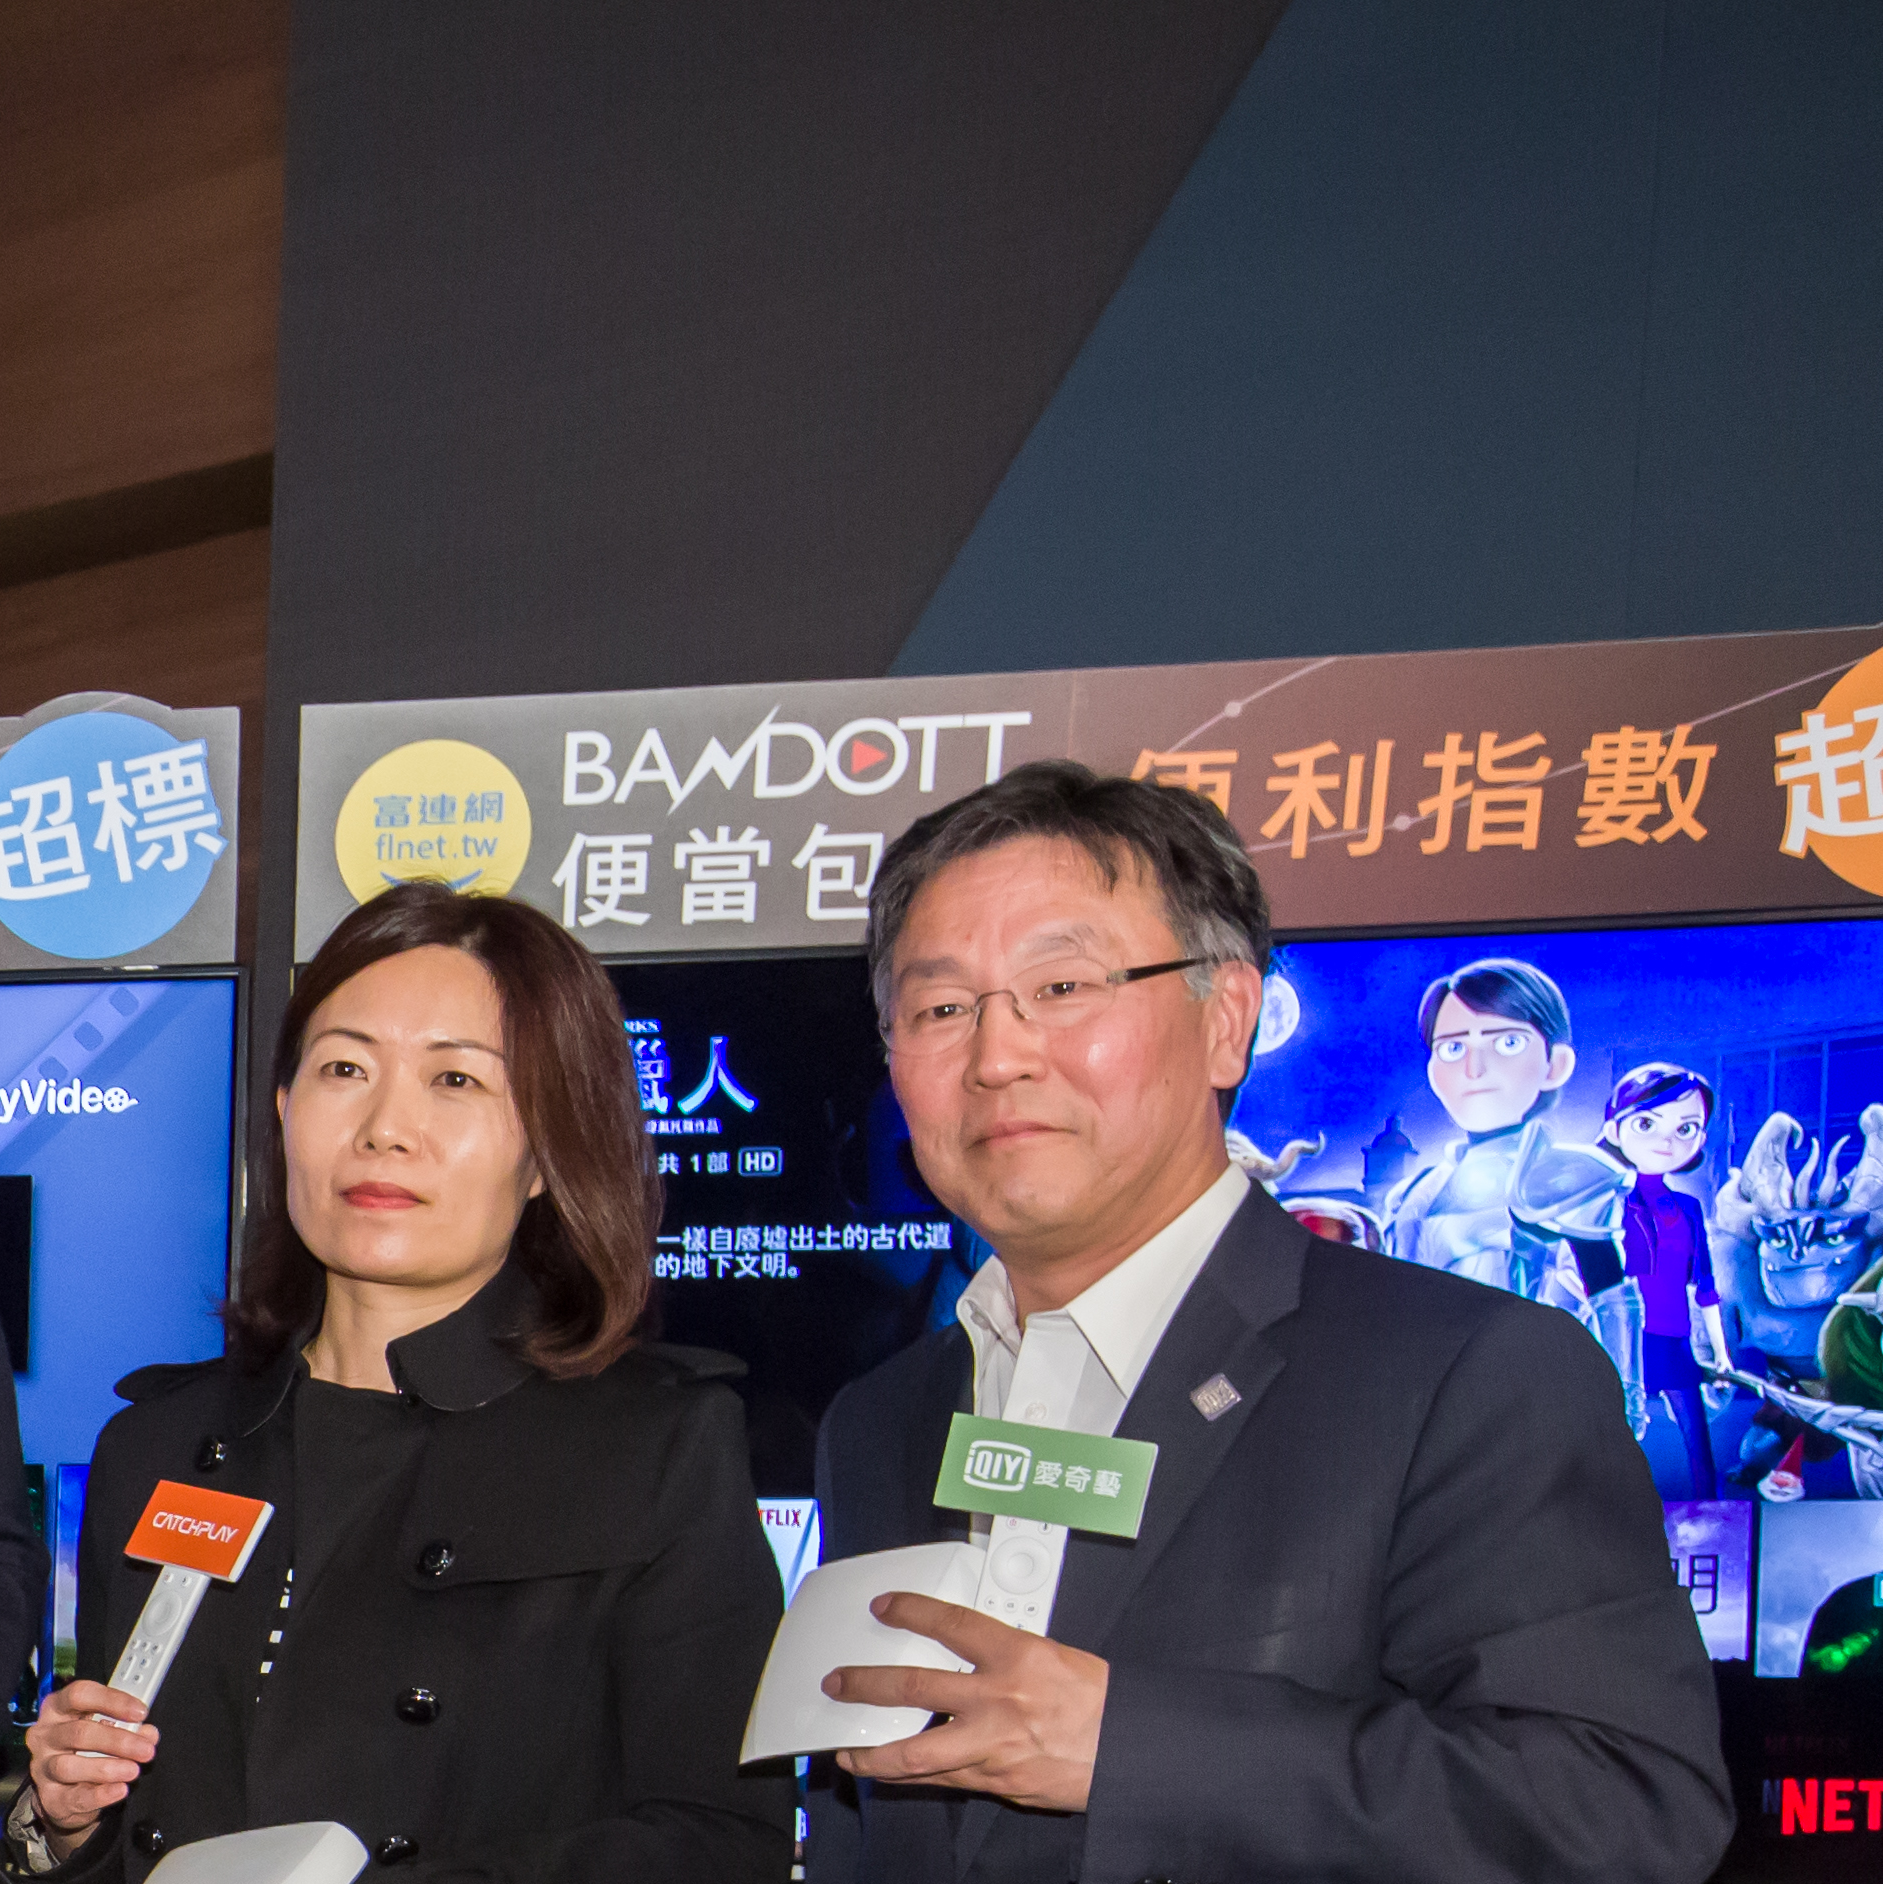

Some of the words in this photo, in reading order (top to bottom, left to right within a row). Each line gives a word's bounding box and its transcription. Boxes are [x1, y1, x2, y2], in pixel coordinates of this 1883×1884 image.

[562, 704, 1032, 816] BANDOTT
[373, 791, 505, 828] 富連網
[1033, 1459, 1124, 1499] 愛奇藝
[152, 1510, 239, 1544] CATCHPLAY
